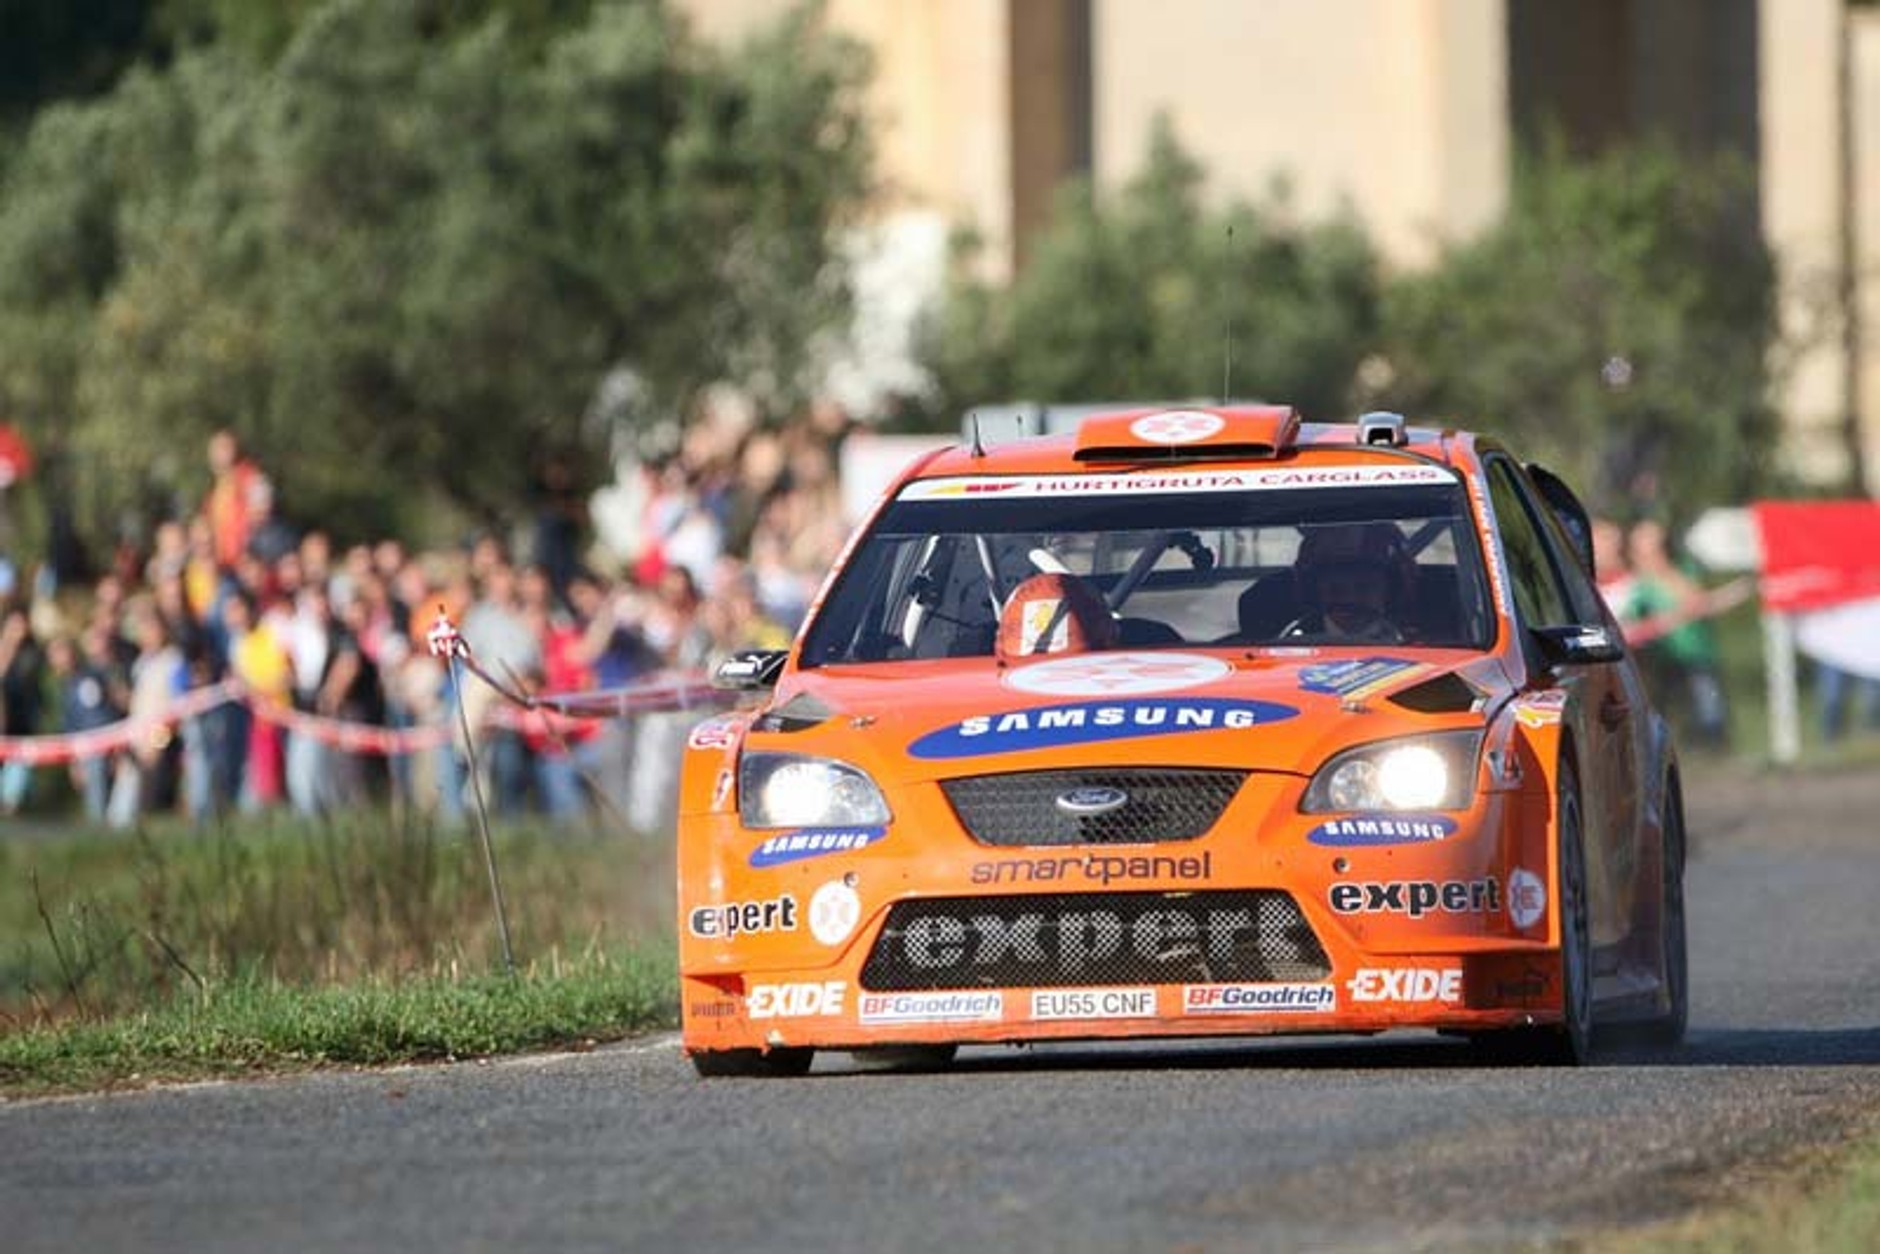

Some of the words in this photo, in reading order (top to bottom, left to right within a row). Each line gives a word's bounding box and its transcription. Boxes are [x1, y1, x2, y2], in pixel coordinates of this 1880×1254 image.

[1035, 475, 1245, 492] HURTIGRUTA
[1260, 470, 1438, 486] CARGLASS
[959, 706, 1256, 737] SAMSUNG
[762, 833, 869, 854] SAMSUNG
[1323, 820, 1446, 840] SAMSUNG
[971, 850, 1211, 885] smartpanel
[1329, 877, 1500, 916] expert
[902, 897, 1302, 976] expert
[1188, 985, 1333, 1006] BFGoodrich
[1347, 968, 1463, 1001] EXIDE
[748, 980, 847, 1020] EXIDE
[862, 994, 1001, 1016] BFGoodrich
[1035, 994, 1096, 1016] EU55
[1102, 992, 1152, 1014] CNF
